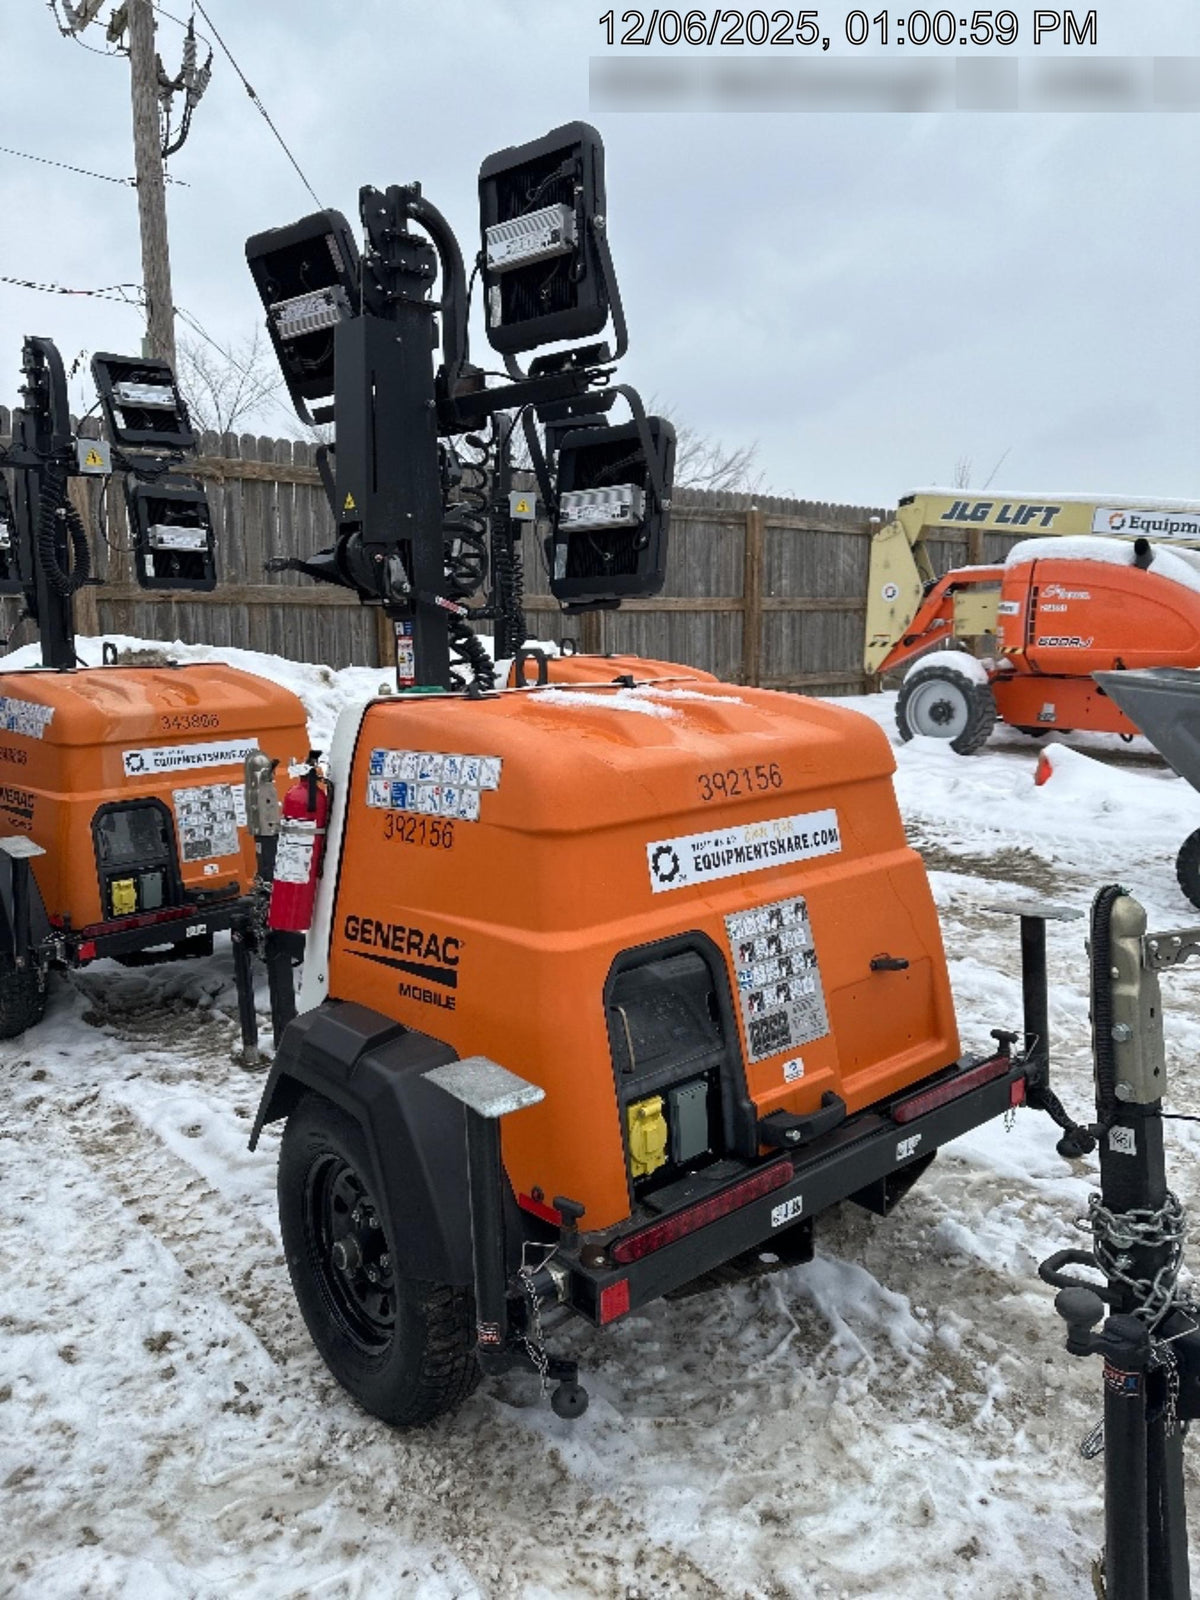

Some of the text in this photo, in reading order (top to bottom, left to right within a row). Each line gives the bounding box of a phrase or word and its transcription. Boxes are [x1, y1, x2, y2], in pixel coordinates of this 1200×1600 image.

[941, 501, 1062, 528] JLG LIFT
[1129, 515, 1200, 535] Equipm
[153, 748, 255, 767] EQUIPMENTSHARE.CO
[698, 763, 783, 801] 392156
[384, 813, 454, 849] 392156
[694, 828, 838, 872] EQUIPMENTSHARE.COM
[344, 914, 460, 966] GENERAC
[398, 982, 457, 1011] MOBILE
